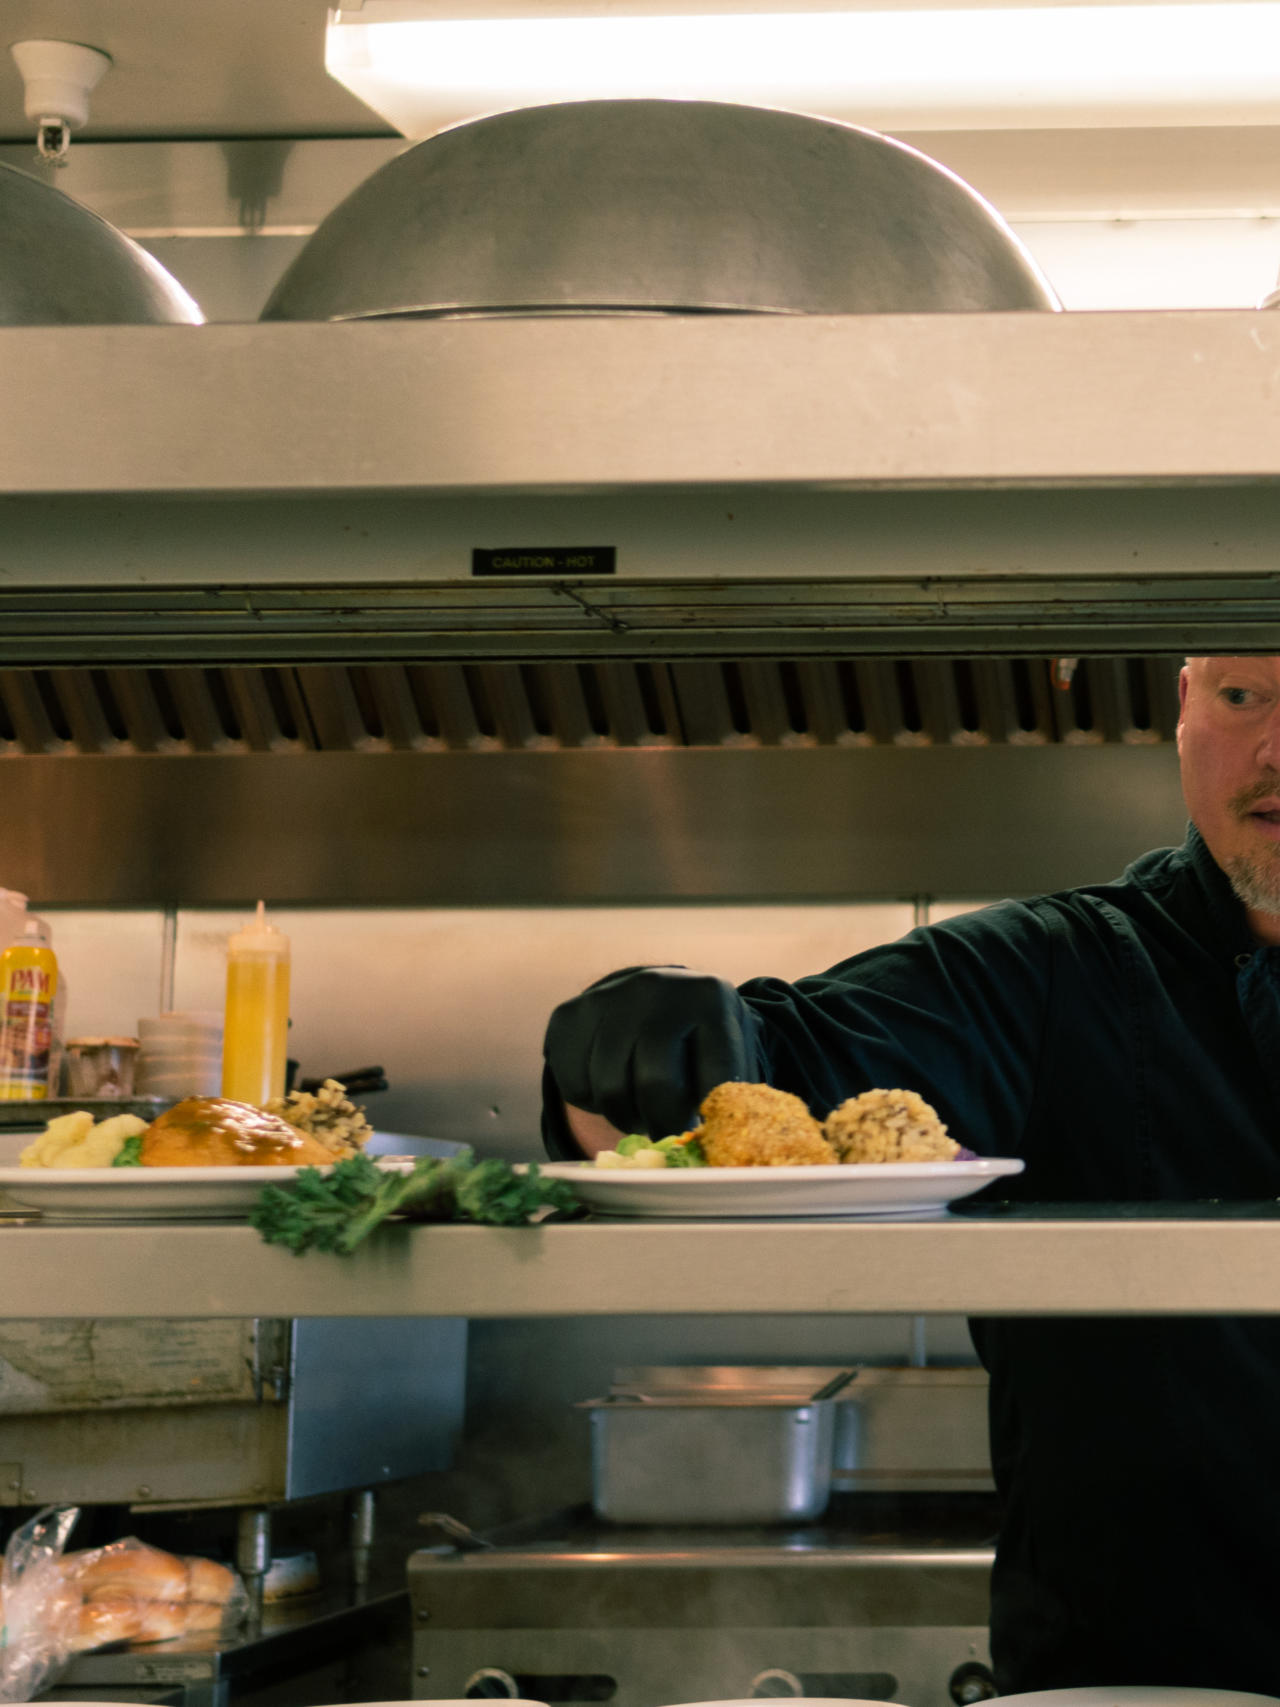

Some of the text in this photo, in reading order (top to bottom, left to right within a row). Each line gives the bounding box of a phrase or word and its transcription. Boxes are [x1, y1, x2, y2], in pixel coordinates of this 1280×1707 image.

[491, 556, 555, 568] CAUTION
[565, 555, 596, 568] HOT
[11, 968, 51, 993] PAM
